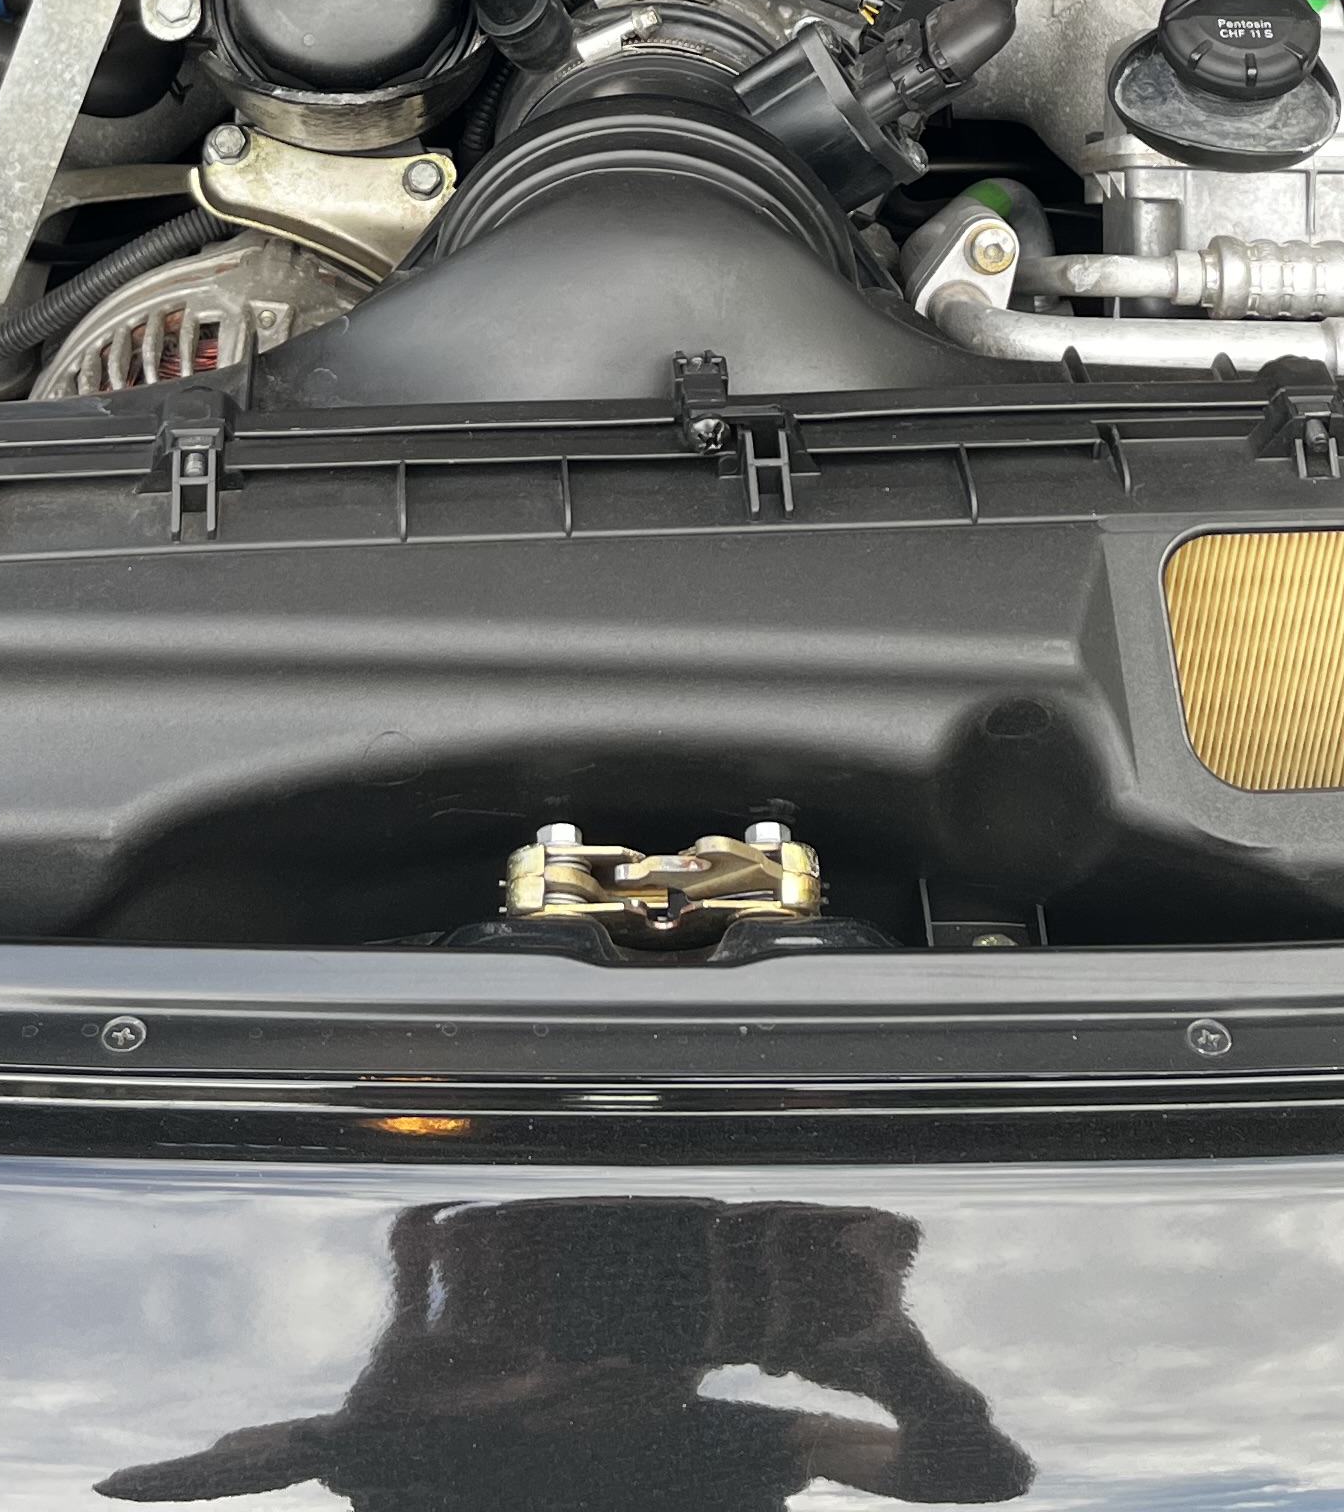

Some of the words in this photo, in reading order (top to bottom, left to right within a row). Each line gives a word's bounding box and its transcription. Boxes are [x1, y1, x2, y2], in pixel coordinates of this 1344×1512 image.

[1217, 19, 1272, 29] Pentosin
[1220, 29, 1245, 39] CHF
[1249, 29, 1260, 39] 11
[1264, 29, 1274, 39] S
